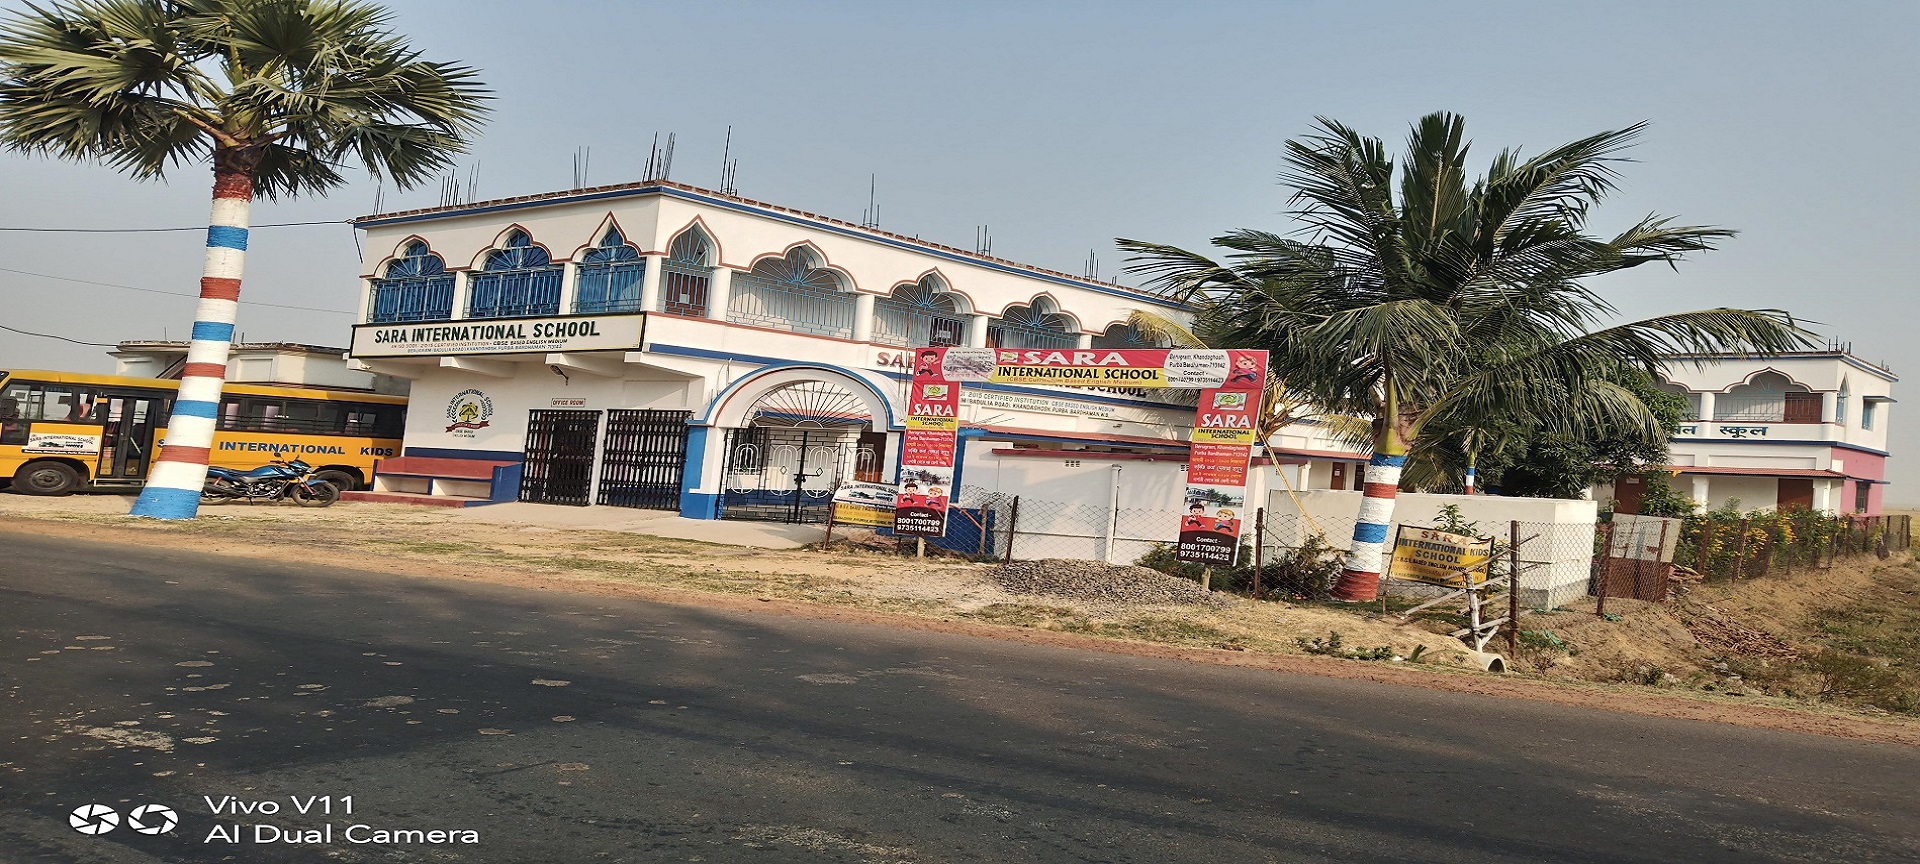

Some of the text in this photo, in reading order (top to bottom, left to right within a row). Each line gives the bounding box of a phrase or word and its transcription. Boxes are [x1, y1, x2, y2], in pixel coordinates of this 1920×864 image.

[375, 321, 600, 343] SARA INTERNATIONAL SCHOOL
[1022, 351, 1129, 366] SARA
[998, 366, 1100, 379] INTERNATIONAL
[1104, 369, 1160, 380] SCHOOL
[984, 393, 1013, 402] CERTIFIED
[1014, 396, 1049, 405] INSTITUTION
[913, 403, 954, 416] SARA
[1201, 413, 1251, 428] SARA
[1720, 426, 1768, 438] स्कूल
[219, 441, 393, 457] INTERNATIONAL KIDS
[854, 484, 887, 492] INTERNATIONAL
[897, 517, 940, 526] 8001700799
[897, 524, 939, 533] 9735114423
[1421, 530, 1468, 545] SARA
[1181, 543, 1231, 553] 8001700799
[1398, 538, 1490, 557] INTERNATIONAL KIDS
[1180, 551, 1230, 561] 9735114423
[1415, 550, 1461, 564] SCHOOL
